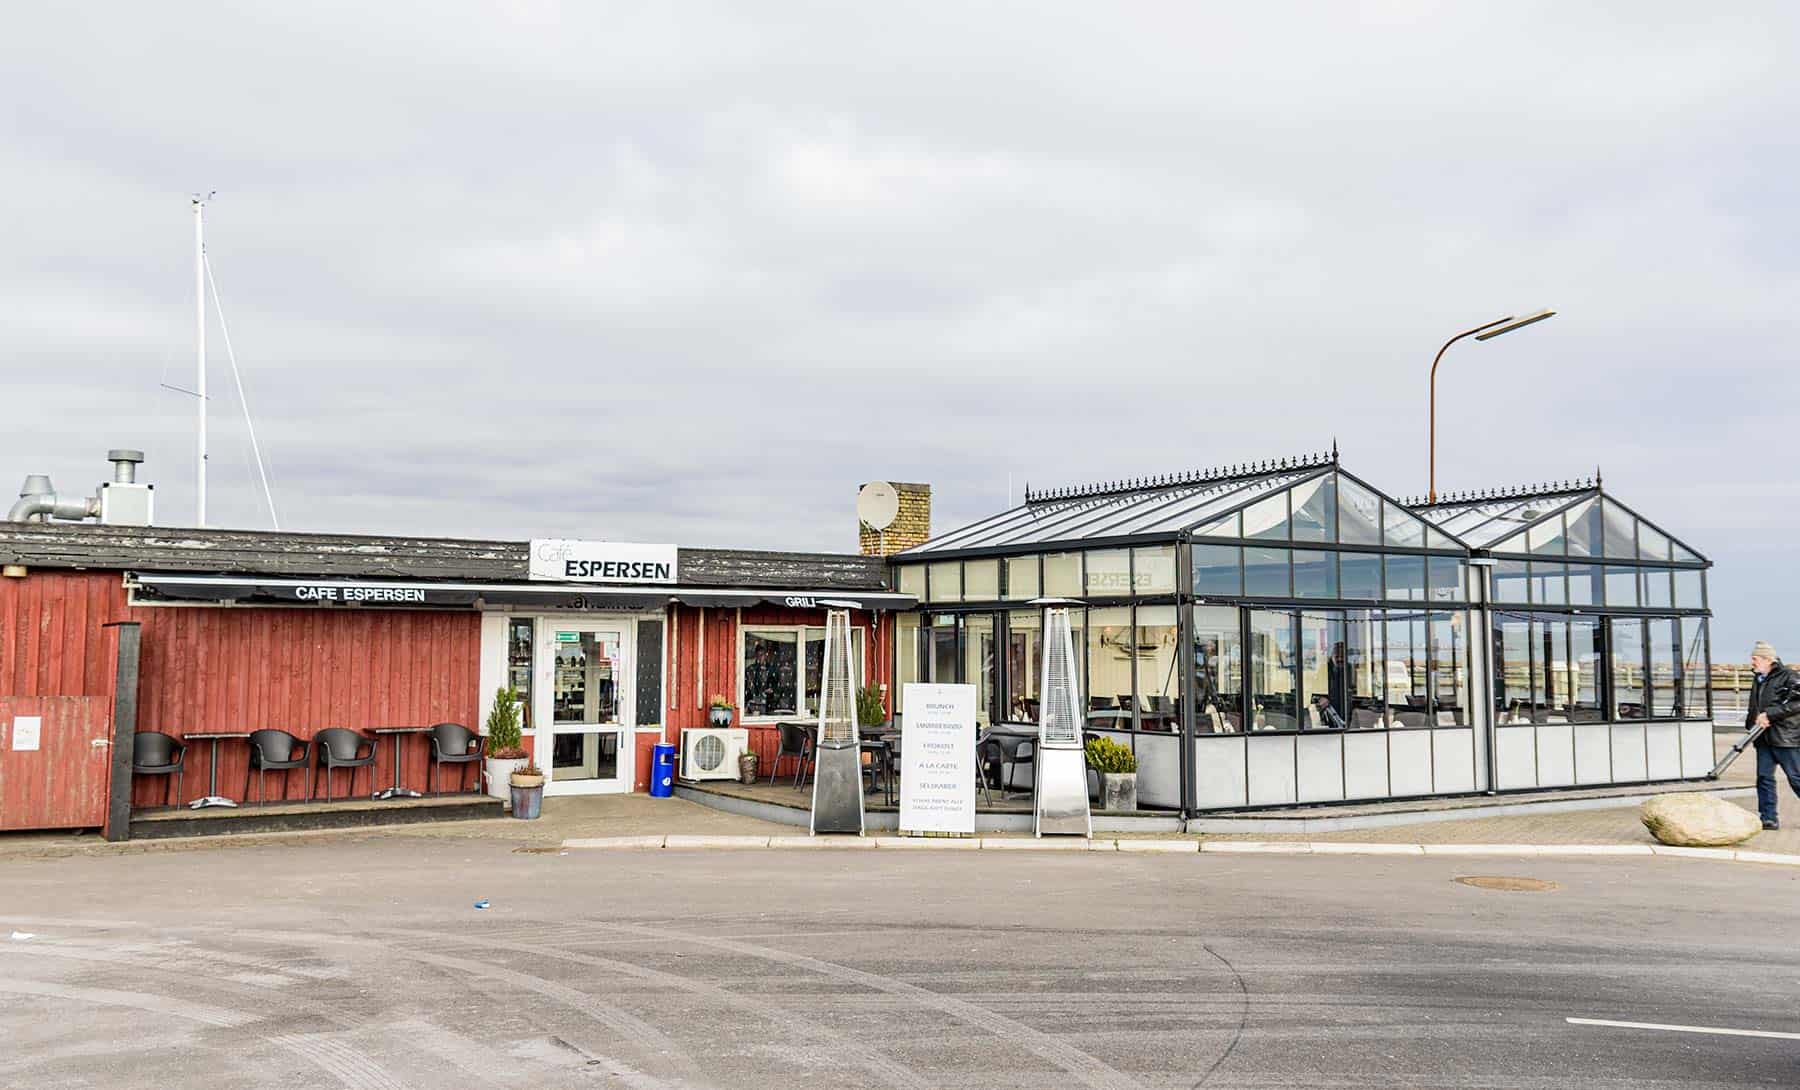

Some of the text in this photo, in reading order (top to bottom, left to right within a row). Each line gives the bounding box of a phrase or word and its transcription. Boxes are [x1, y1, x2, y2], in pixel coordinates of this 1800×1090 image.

[565, 560, 670, 579] ESPERSEN
[295, 587, 425, 601] CAFE ESPERSEN
